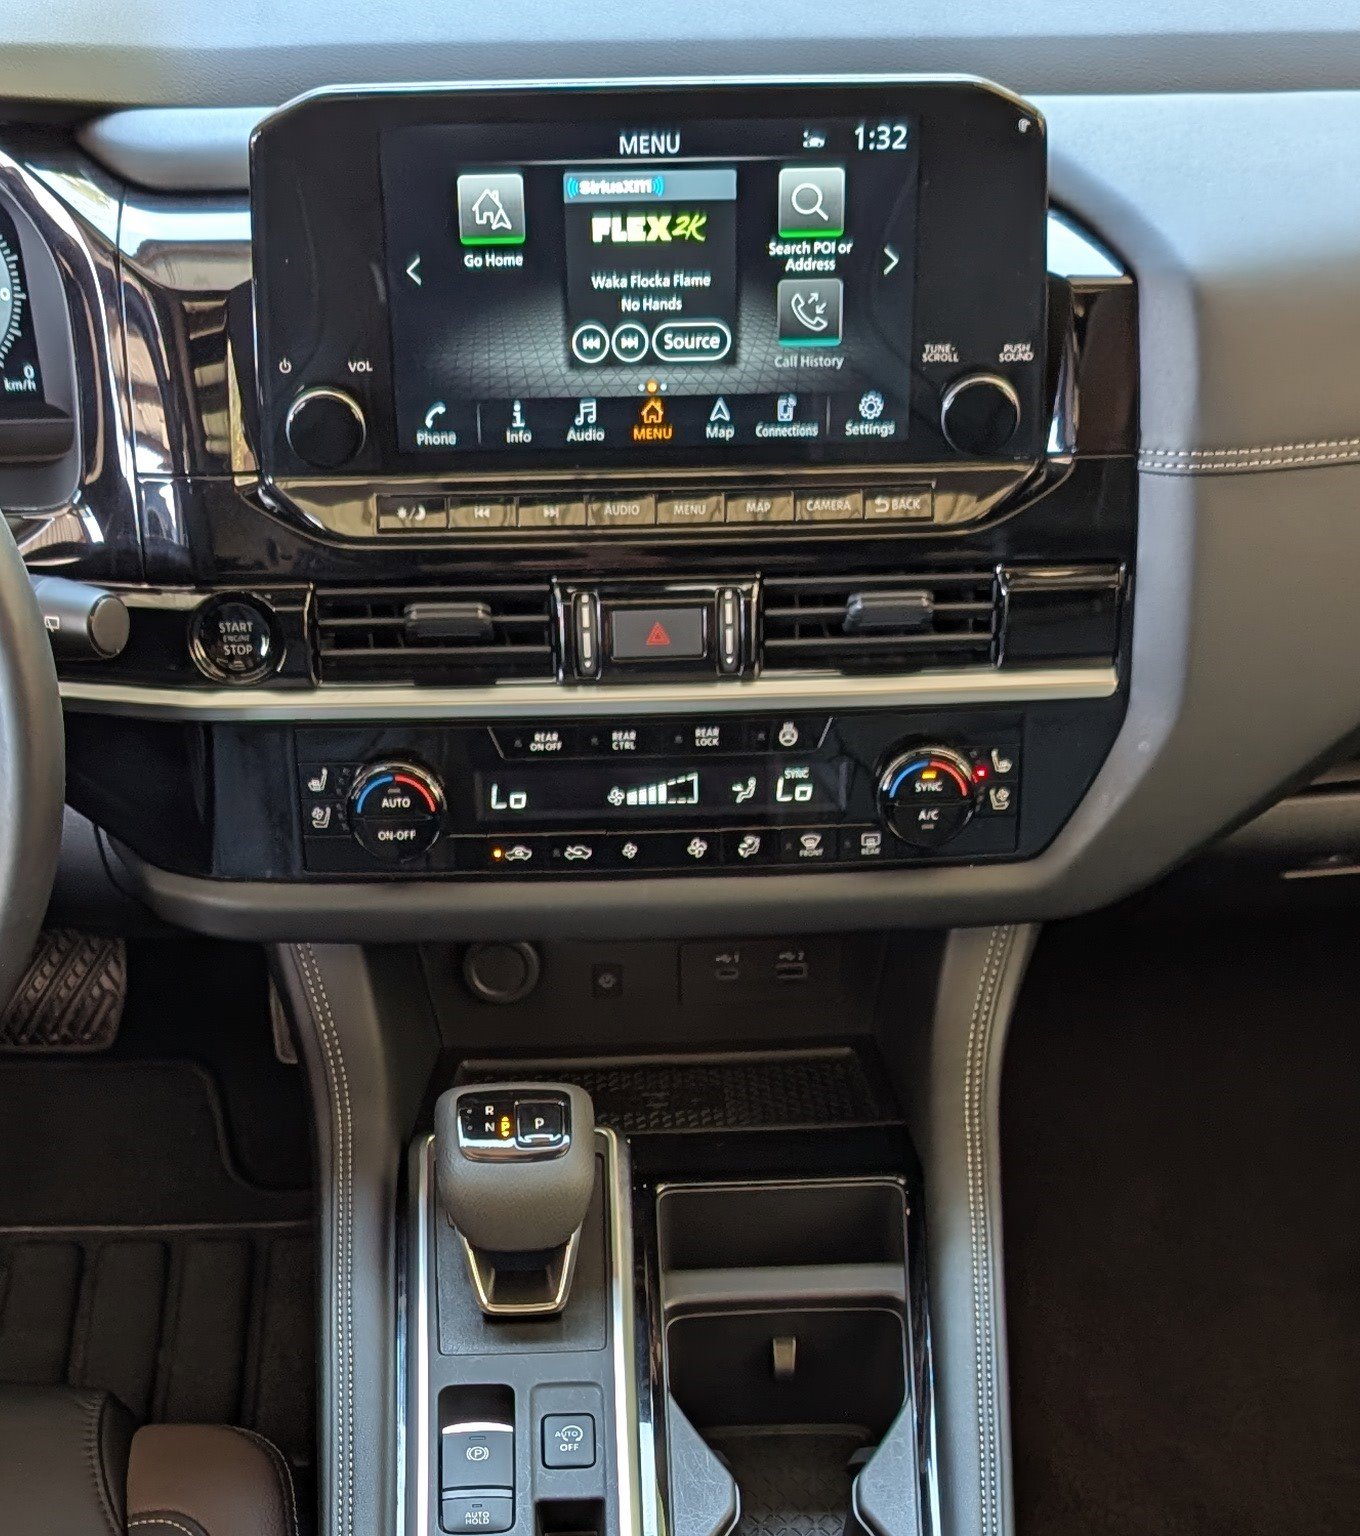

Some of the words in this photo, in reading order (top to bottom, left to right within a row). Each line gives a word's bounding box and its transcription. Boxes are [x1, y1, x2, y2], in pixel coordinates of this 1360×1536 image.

[618, 133, 681, 154] MENU
[854, 125, 907, 150] 1:32
[591, 215, 673, 242] FLEX
[671, 214, 706, 241] 2K
[769, 242, 811, 256] Search
[813, 241, 836, 255] POI
[837, 243, 853, 254] or
[464, 254, 483, 267] Go
[485, 253, 524, 267] Home
[785, 257, 836, 271] Address
[591, 274, 628, 289] Waka
[630, 273, 671, 289] Flocka
[673, 273, 711, 288] Flame
[621, 298, 640, 312] No
[642, 297, 682, 312] Hands
[663, 333, 720, 350] Source
[774, 355, 802, 369] Call
[803, 354, 845, 370] History
[922, 352, 959, 362] SCROLL
[24, 364, 35, 379] 0
[348, 361, 374, 373] VOL
[4, 376, 36, 392] km/h
[506, 430, 532, 443] Info
[566, 428, 605, 442] Audio
[633, 427, 673, 441] MENU
[706, 426, 735, 441] Map
[755, 424, 819, 438] Connections
[845, 423, 895, 438] Settings
[416, 432, 457, 445] Phone
[604, 505, 640, 516] AUDIO
[674, 504, 706, 516] MENU
[746, 503, 771, 513] MAP
[806, 500, 852, 512] CAMERA
[892, 499, 921, 511] BACK
[219, 622, 253, 633] START
[223, 644, 253, 656] STOP
[534, 732, 559, 742] REAR
[611, 730, 637, 741] REAR
[695, 727, 720, 738] REAR
[611, 741, 636, 751] CTRL
[695, 737, 720, 747] LOCK
[784, 767, 810, 779] SYNC
[915, 781, 943, 793] SYNC
[381, 798, 411, 808] AUTO
[918, 809, 939, 821] A/C
[377, 829, 416, 841] ON-OFF
[485, 1105, 495, 1116] R
[484, 1122, 496, 1132] N
[534, 1117, 545, 1130] P
[555, 1430, 579, 1438] AUTO
[559, 1443, 579, 1452] OFF
[465, 1511, 490, 1519] AUTO
[465, 1517, 490, 1525] HOLD
